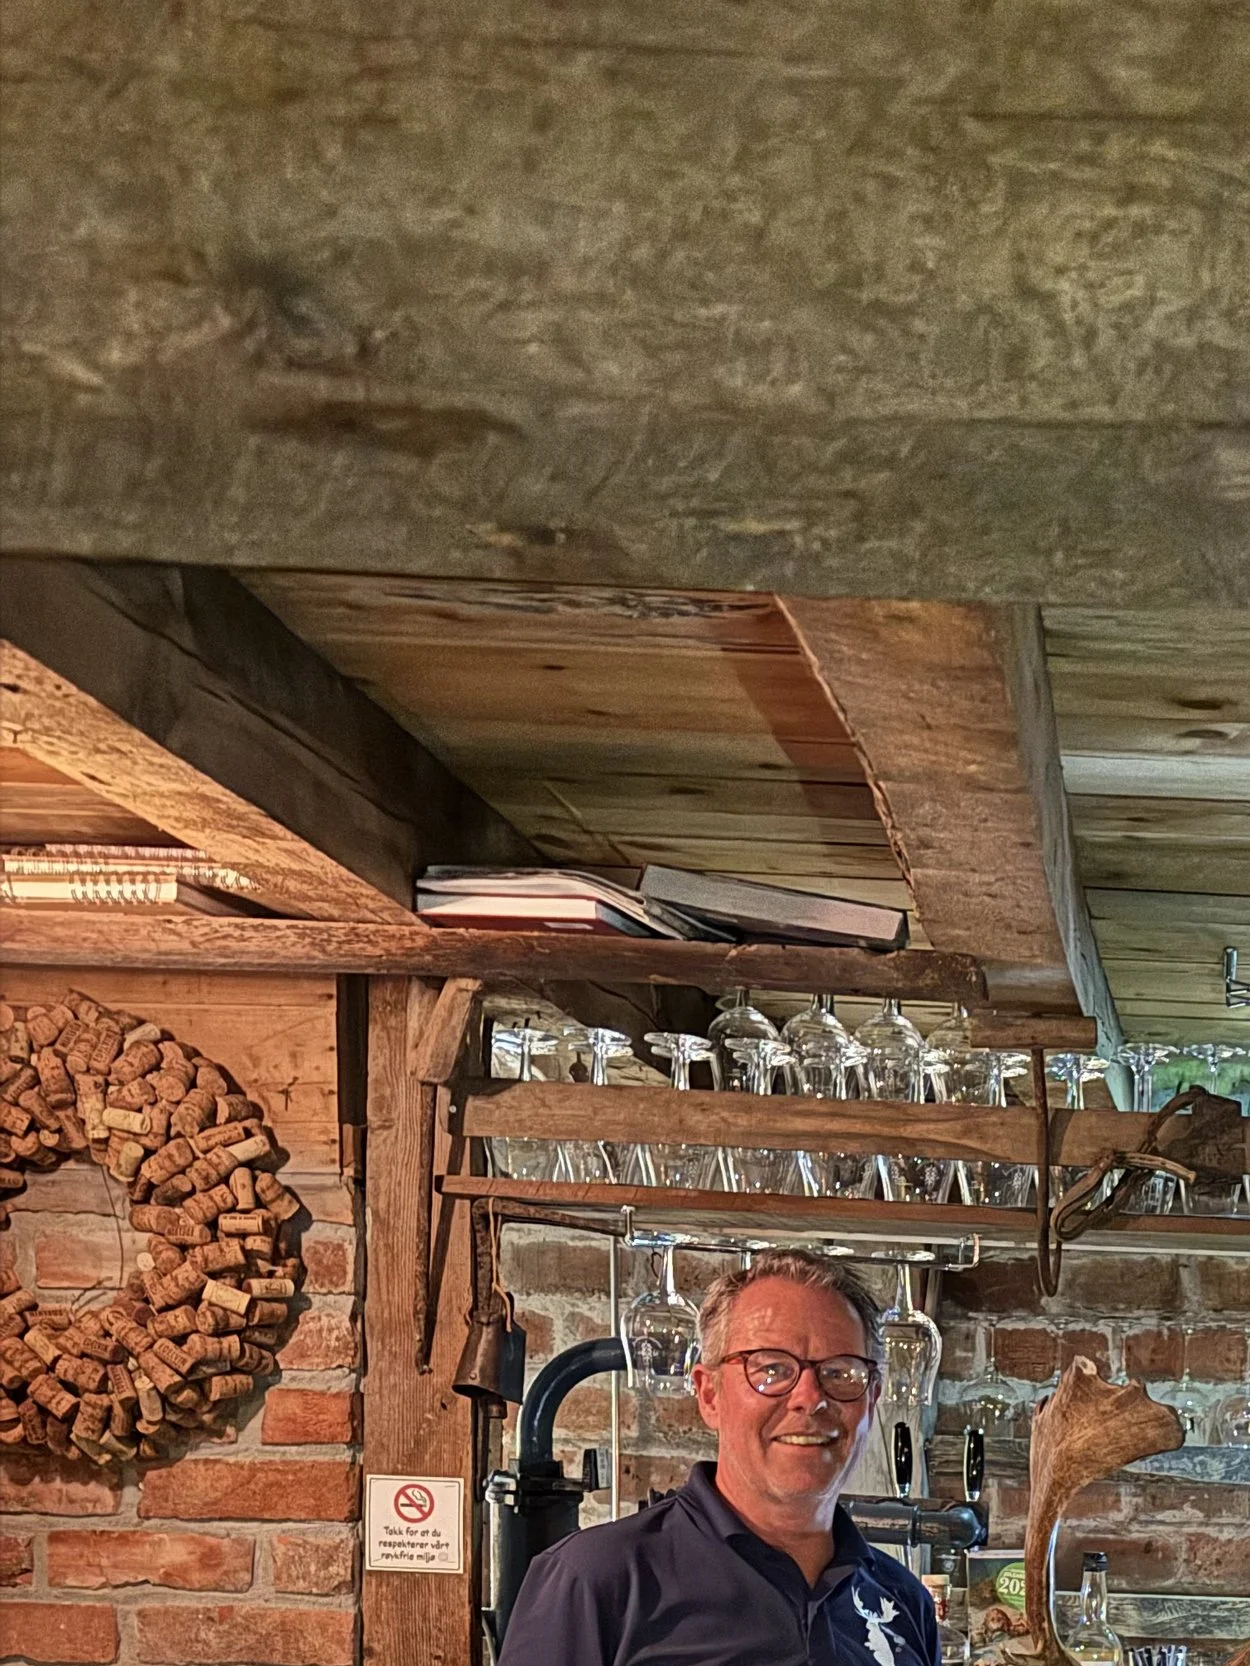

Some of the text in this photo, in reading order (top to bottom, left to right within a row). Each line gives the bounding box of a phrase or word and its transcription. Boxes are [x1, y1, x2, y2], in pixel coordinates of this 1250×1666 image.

[383, 1526, 441, 1537] Takk for at du
[378, 1539, 450, 1550] respekterer vårt
[380, 1550, 436, 1563] røykfrie miljø
